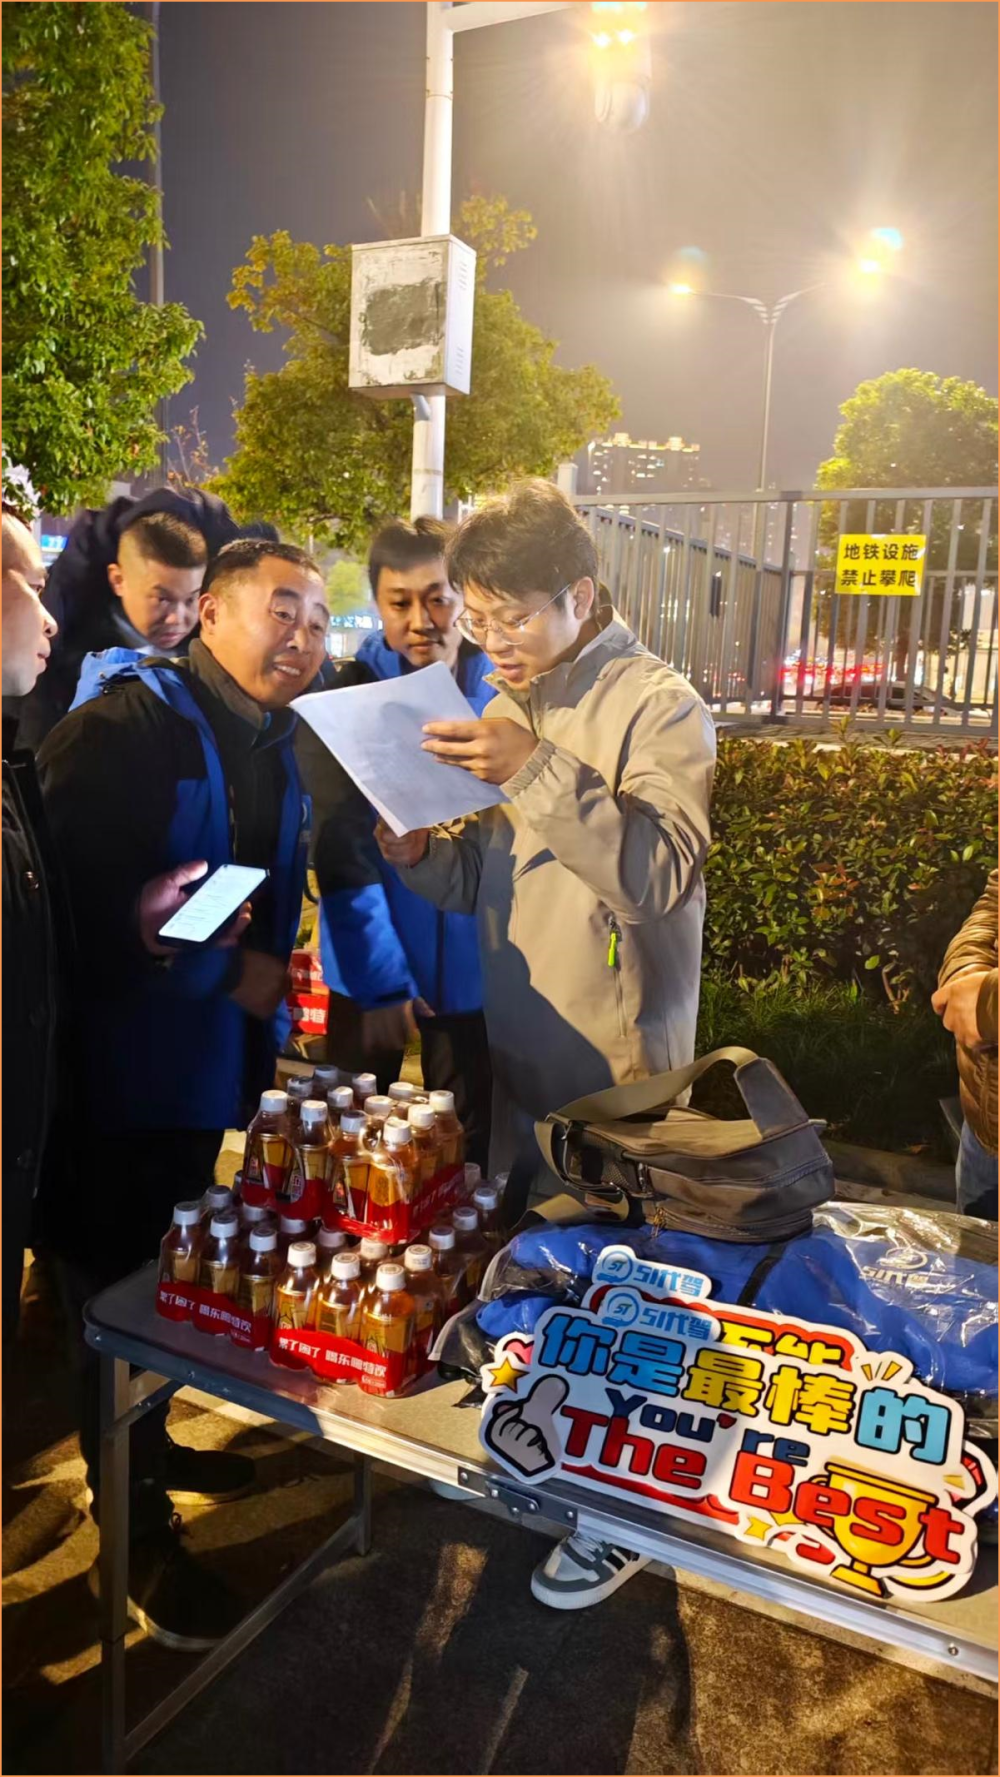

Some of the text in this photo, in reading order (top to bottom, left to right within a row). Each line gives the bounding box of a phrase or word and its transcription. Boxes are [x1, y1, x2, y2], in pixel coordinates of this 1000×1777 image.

[840, 569, 916, 587] 禁止攀爬
[843, 543, 920, 561] 地铁设施
[538, 1313, 951, 1466] 你是最棒的
[560, 1405, 965, 1565] The Best
